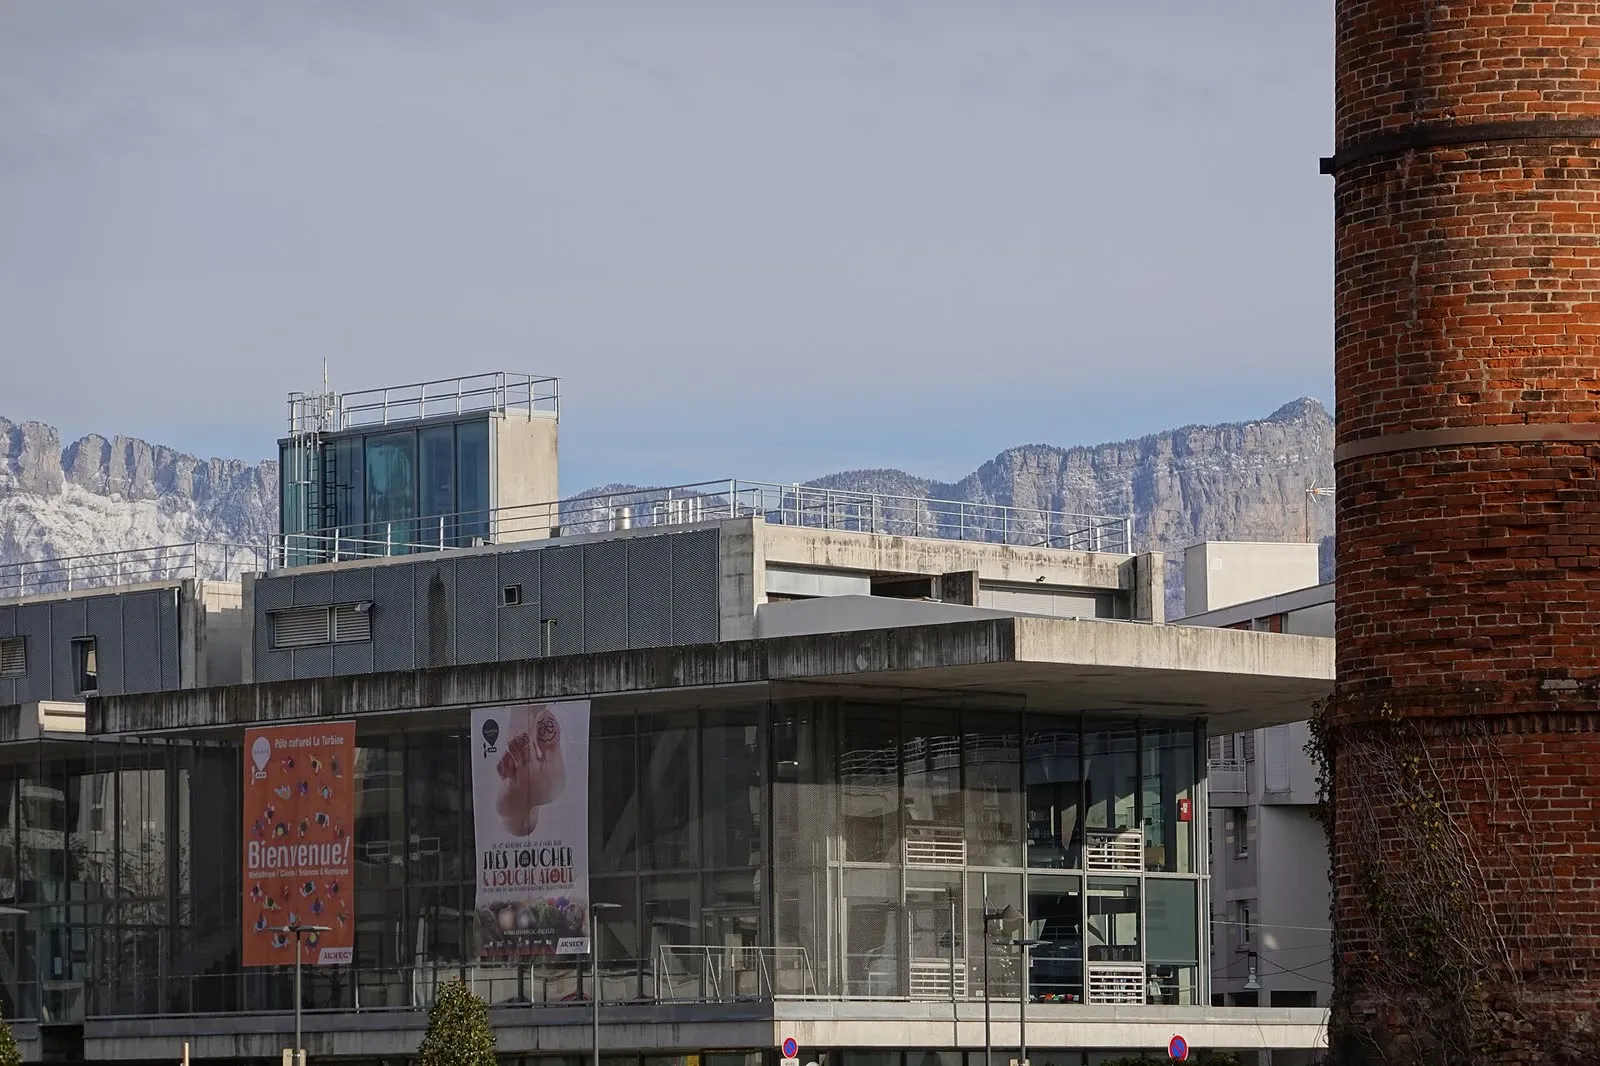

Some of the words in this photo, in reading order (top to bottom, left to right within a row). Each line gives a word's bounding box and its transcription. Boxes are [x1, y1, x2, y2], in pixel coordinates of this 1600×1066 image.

[275, 738, 288, 748] Pôle
[289, 737, 312, 747] culturel
[313, 736, 320, 746] La
[322, 735, 344, 746] Turbine
[248, 836, 350, 868] Bienvenue!
[484, 850, 508, 869] TRÈS
[514, 848, 573, 868] TOUCHER
[483, 872, 489, 886] &
[493, 869, 536, 886] TOUCHE
